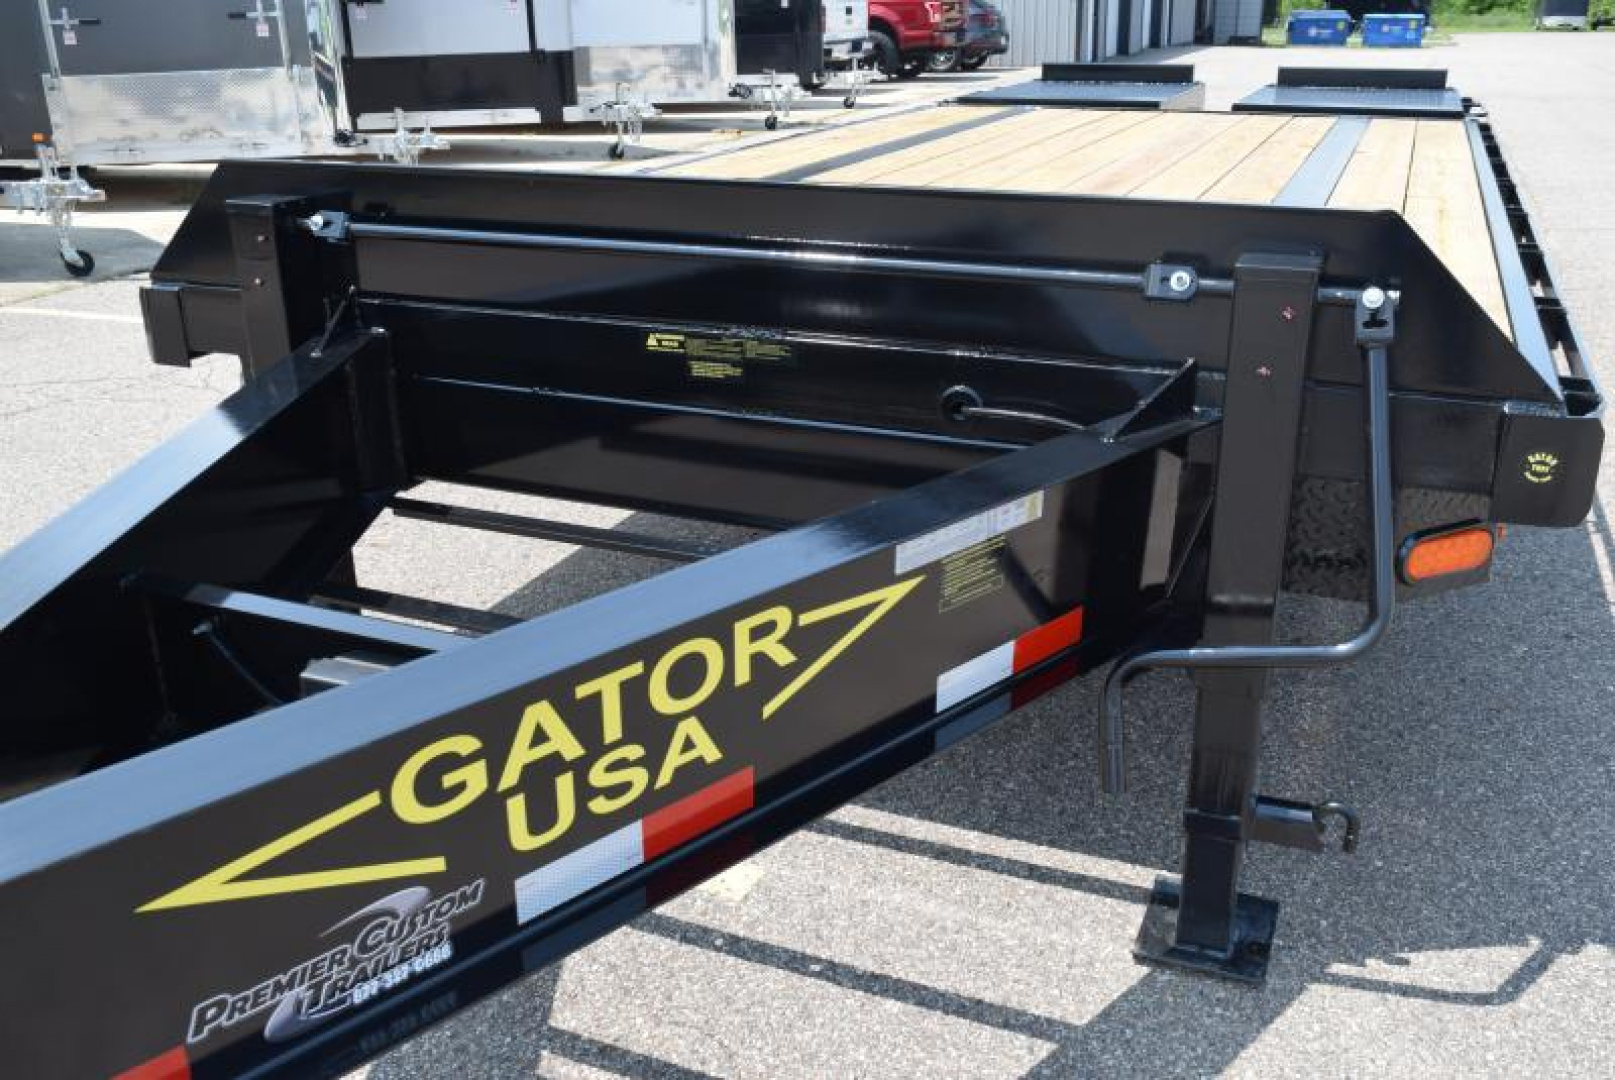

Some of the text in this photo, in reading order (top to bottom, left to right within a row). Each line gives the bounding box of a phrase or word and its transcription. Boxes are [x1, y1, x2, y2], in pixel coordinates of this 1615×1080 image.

[390, 605, 798, 825] GATOR
[506, 716, 724, 852] USA
[186, 944, 353, 1044] PREMIER
[352, 877, 486, 959] CUSTOM
[299, 921, 452, 1020] TRAILERS
